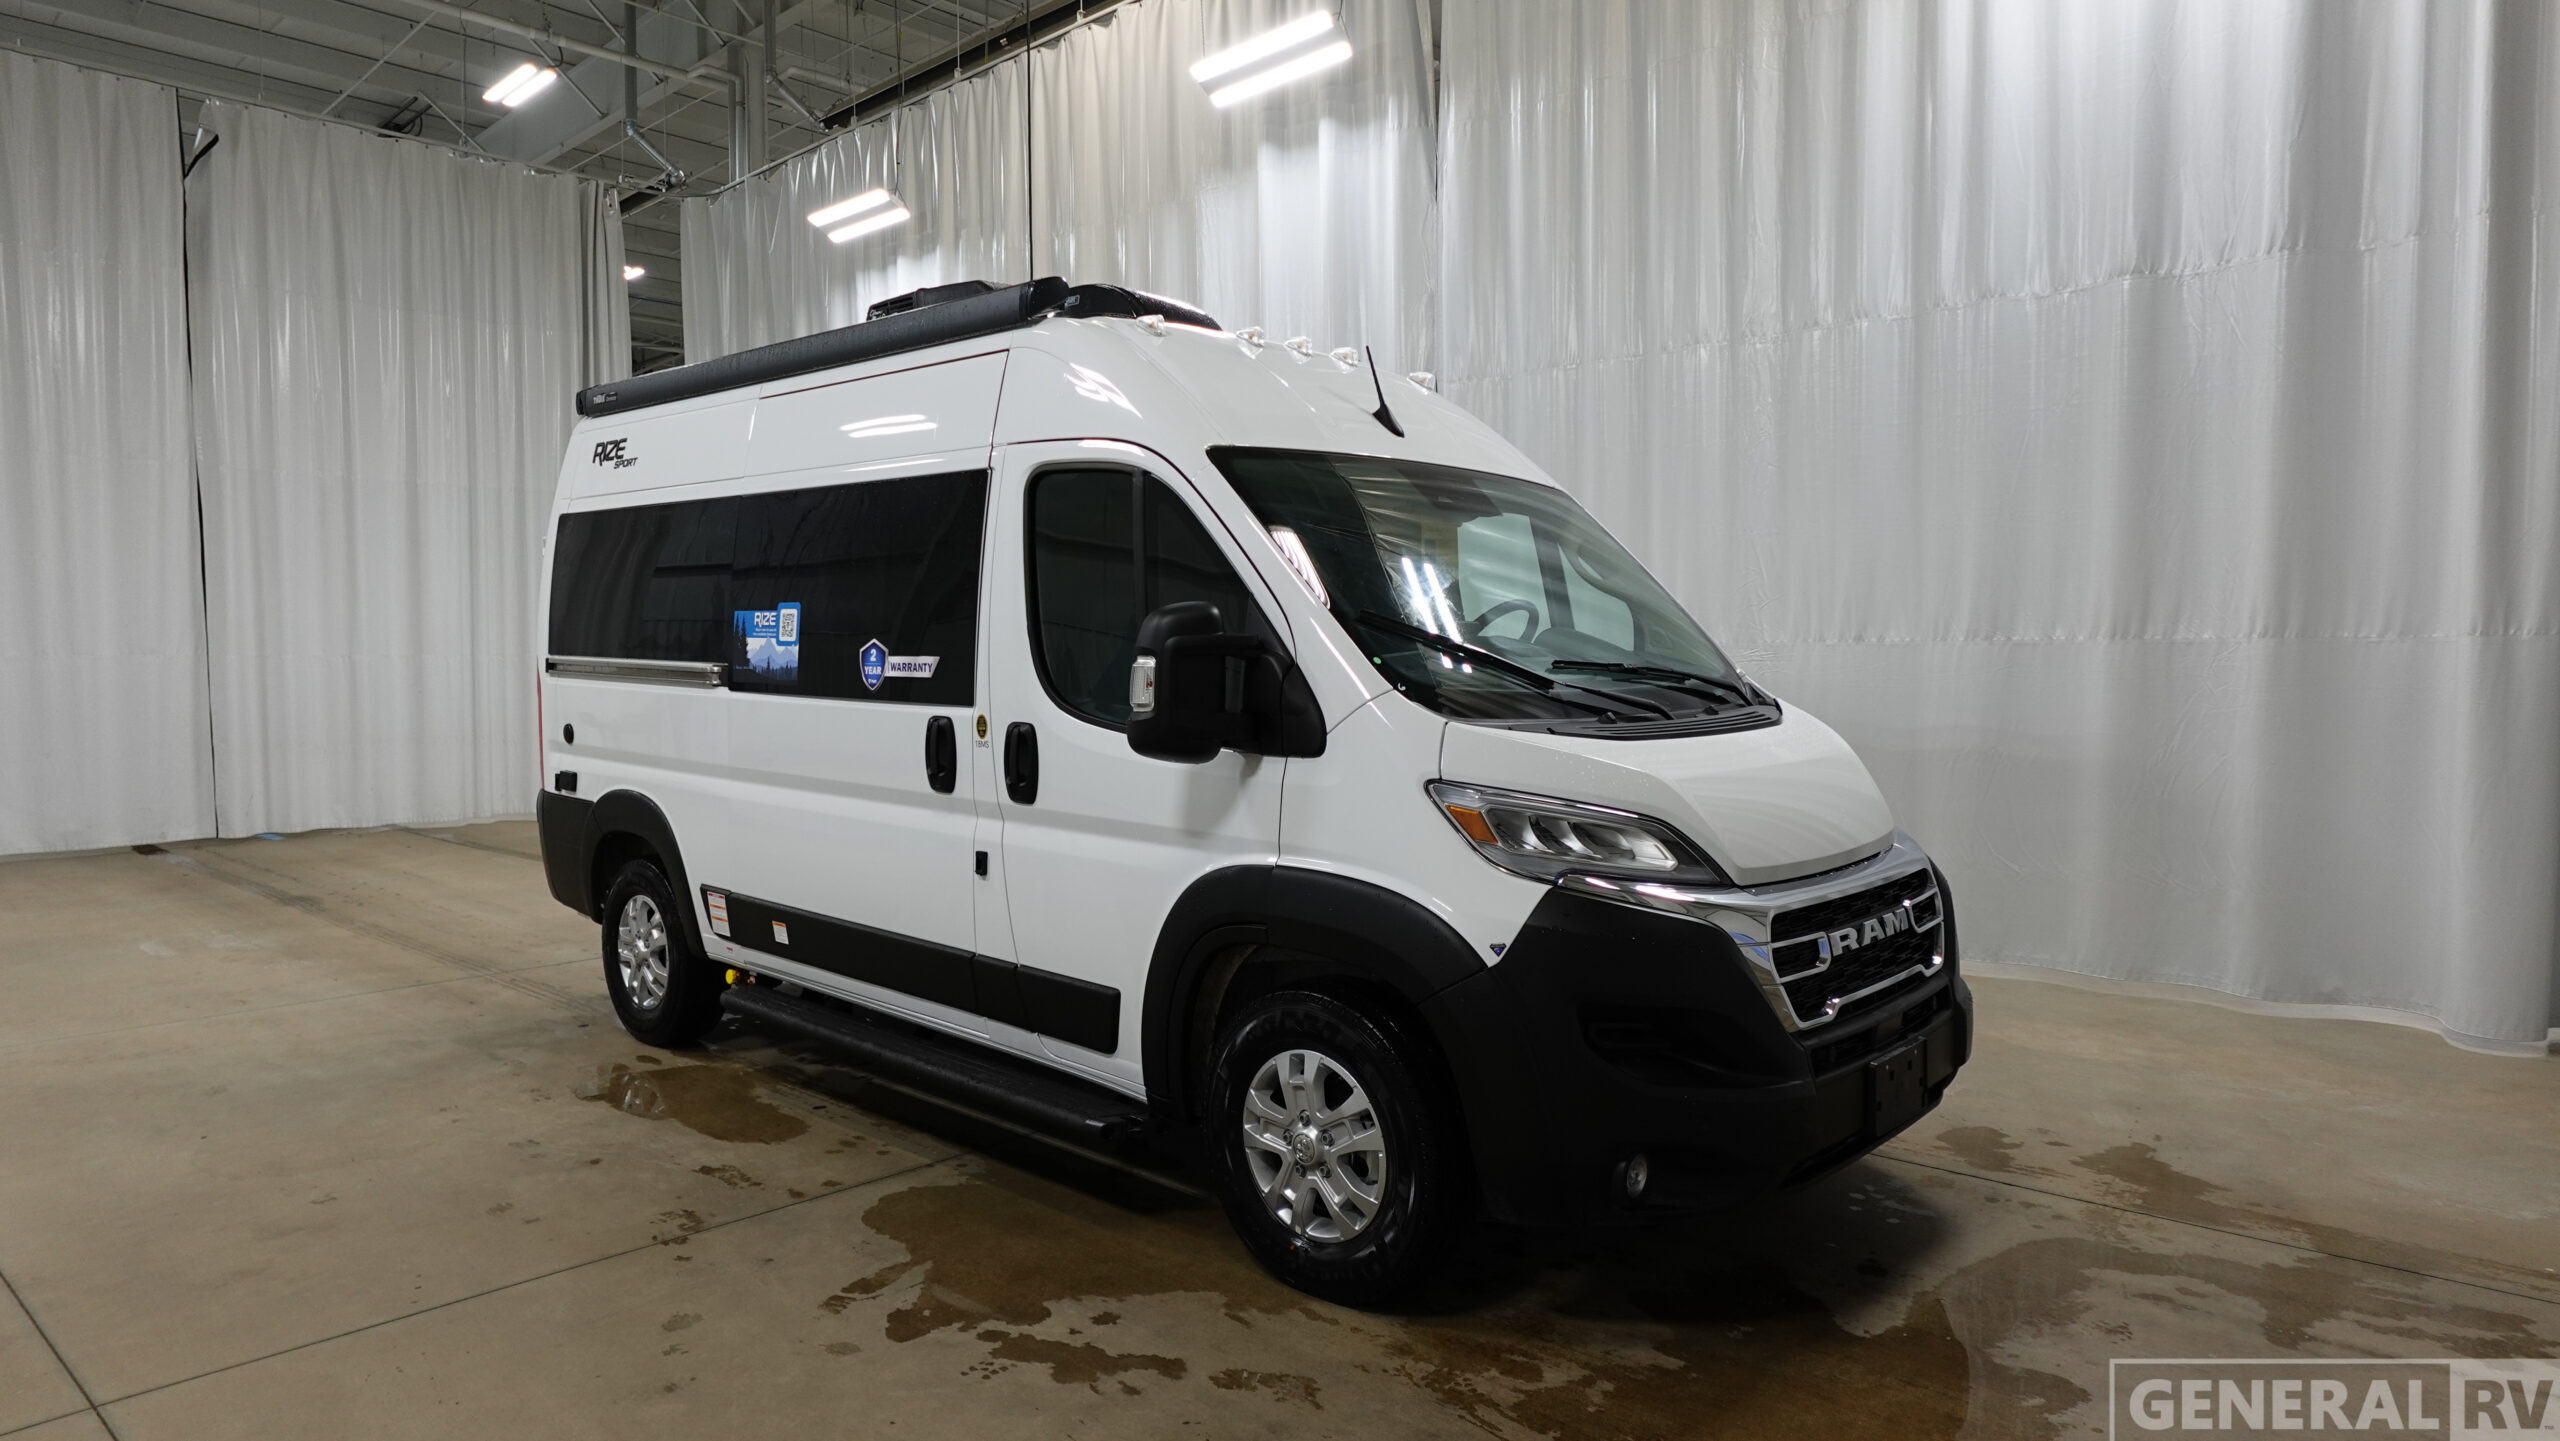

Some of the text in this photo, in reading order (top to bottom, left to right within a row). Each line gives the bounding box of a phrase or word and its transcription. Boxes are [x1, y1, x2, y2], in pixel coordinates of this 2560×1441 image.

[592, 438, 628, 466] RIZE
[613, 457, 638, 469] SPORT
[754, 612, 777, 628] RIZE
[870, 648, 877, 662] 2
[864, 666, 882, 675] YEAR
[890, 662, 933, 673] WARRANTY
[1828, 907, 1909, 957] RAM
